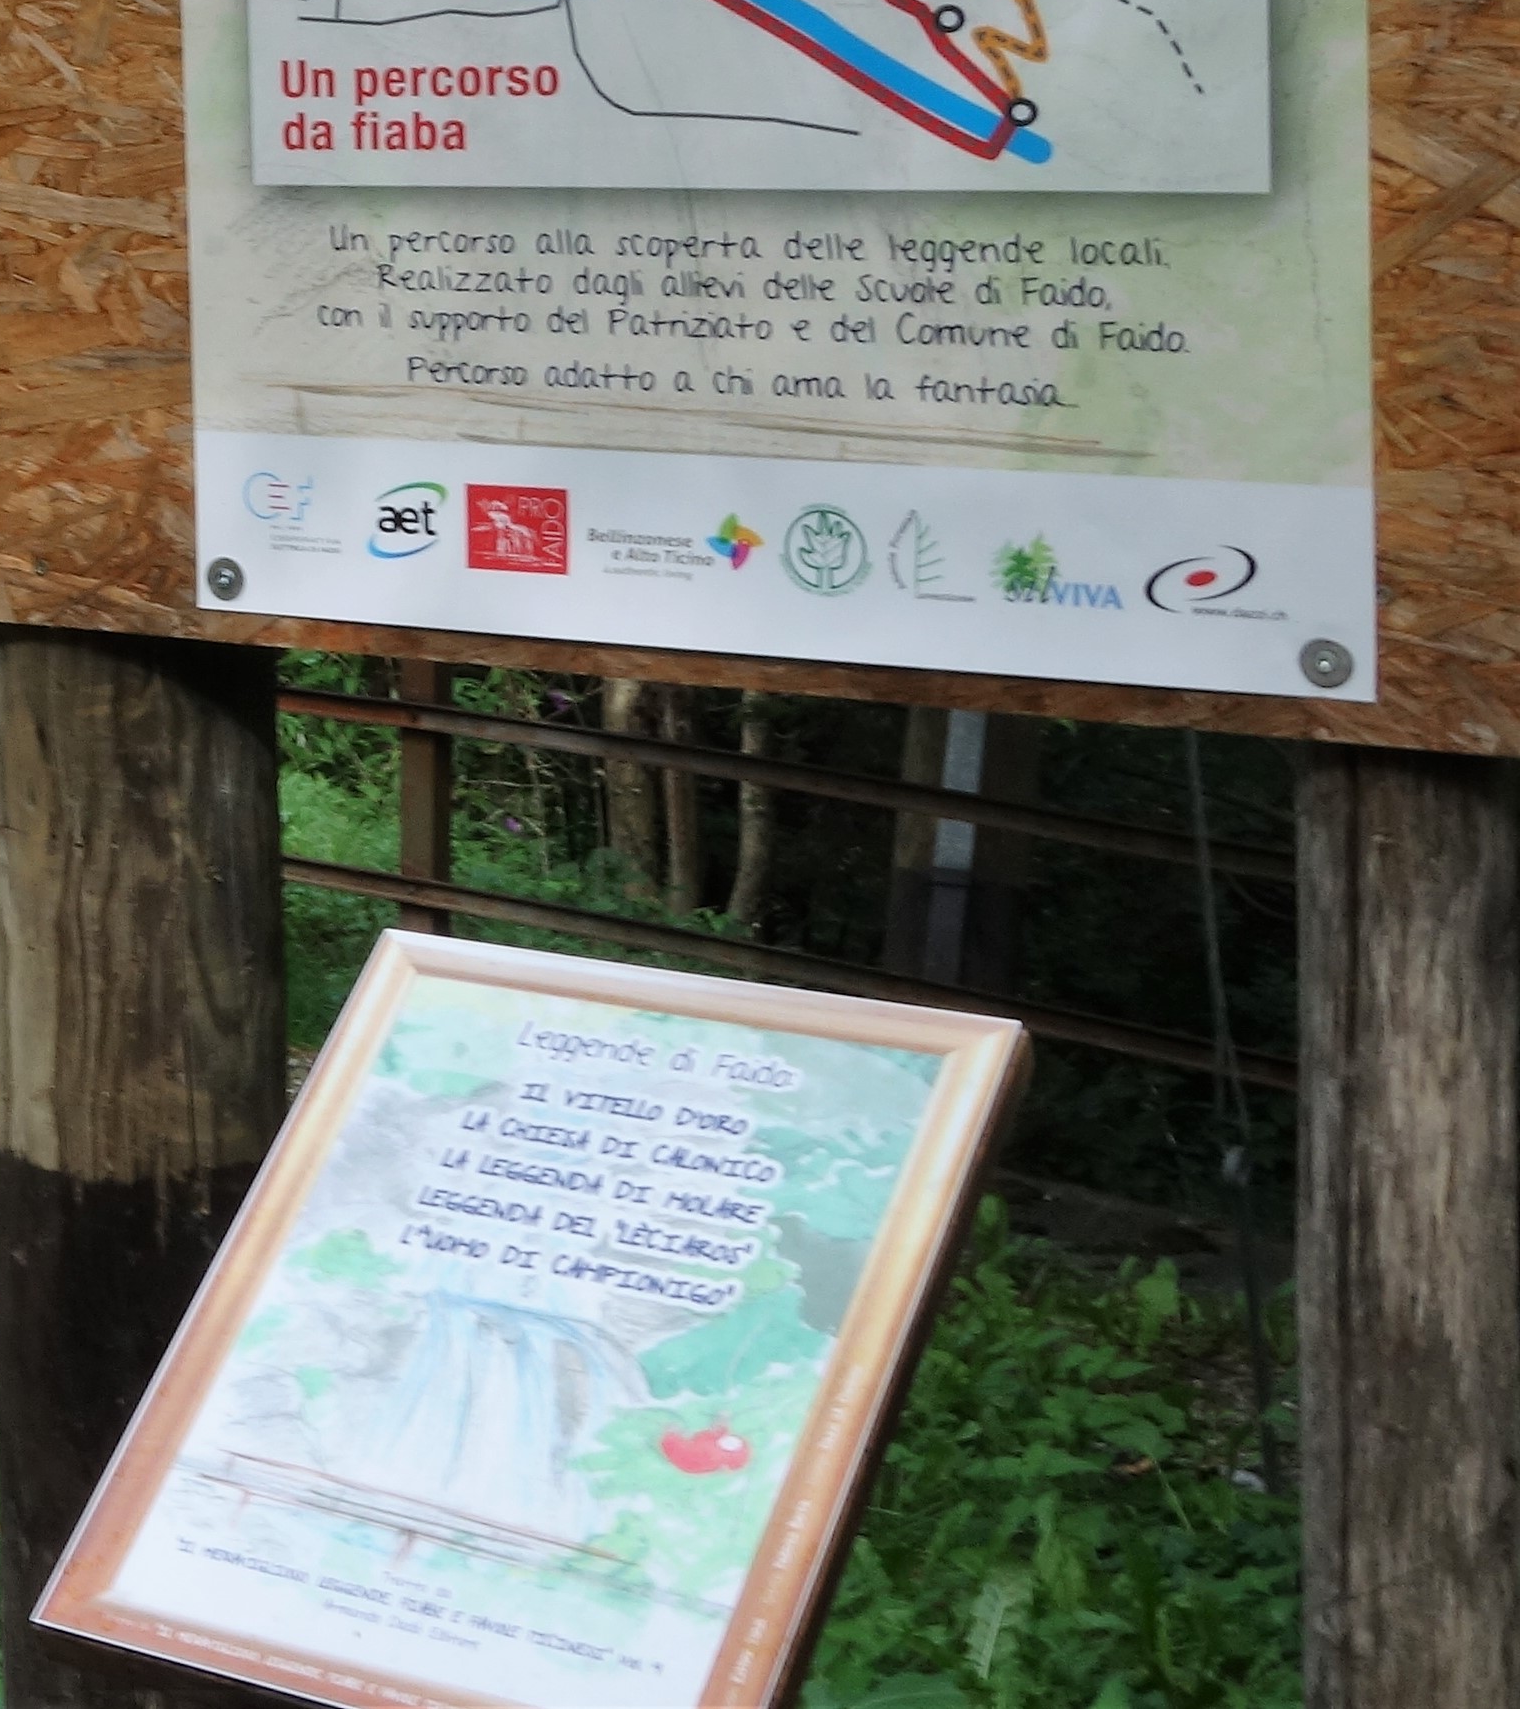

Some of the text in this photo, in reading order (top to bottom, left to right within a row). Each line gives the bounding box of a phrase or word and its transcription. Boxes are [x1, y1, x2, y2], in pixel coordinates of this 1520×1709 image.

[279, 60, 560, 110] Un percorso
[281, 111, 466, 154] da fiaba
[328, 223, 369, 252] Un
[387, 229, 516, 264] percorso
[535, 228, 595, 255] alla
[617, 231, 762, 269] scoperta
[783, 230, 866, 261] delle
[889, 232, 1045, 274] leggende
[376, 262, 1112, 312] Realizzato dagli allievi delle Scuole di Faido,
[316, 302, 1191, 354] con il supporto del Patriziato e del Comune di Faido.
[407, 356, 529, 386] Percorso
[544, 361, 656, 391] adatto
[674, 370, 694, 392] a
[712, 366, 754, 395] chi
[771, 375, 845, 401] ama
[864, 372, 894, 401] la
[377, 500, 437, 538] aet
[517, 1021, 657, 1067] Leggende
[669, 1037, 696, 1073] di
[566, 1089, 664, 1120] VITELLO
[461, 1110, 777, 1183] LA CHIESA DI CALONICO
[440, 1147, 765, 1224] LA LEGGENDA DI MOLARE
[417, 1186, 544, 1225] LEGGENDA
[552, 1211, 598, 1238] DEL
[499, 1244, 541, 1269] DI
